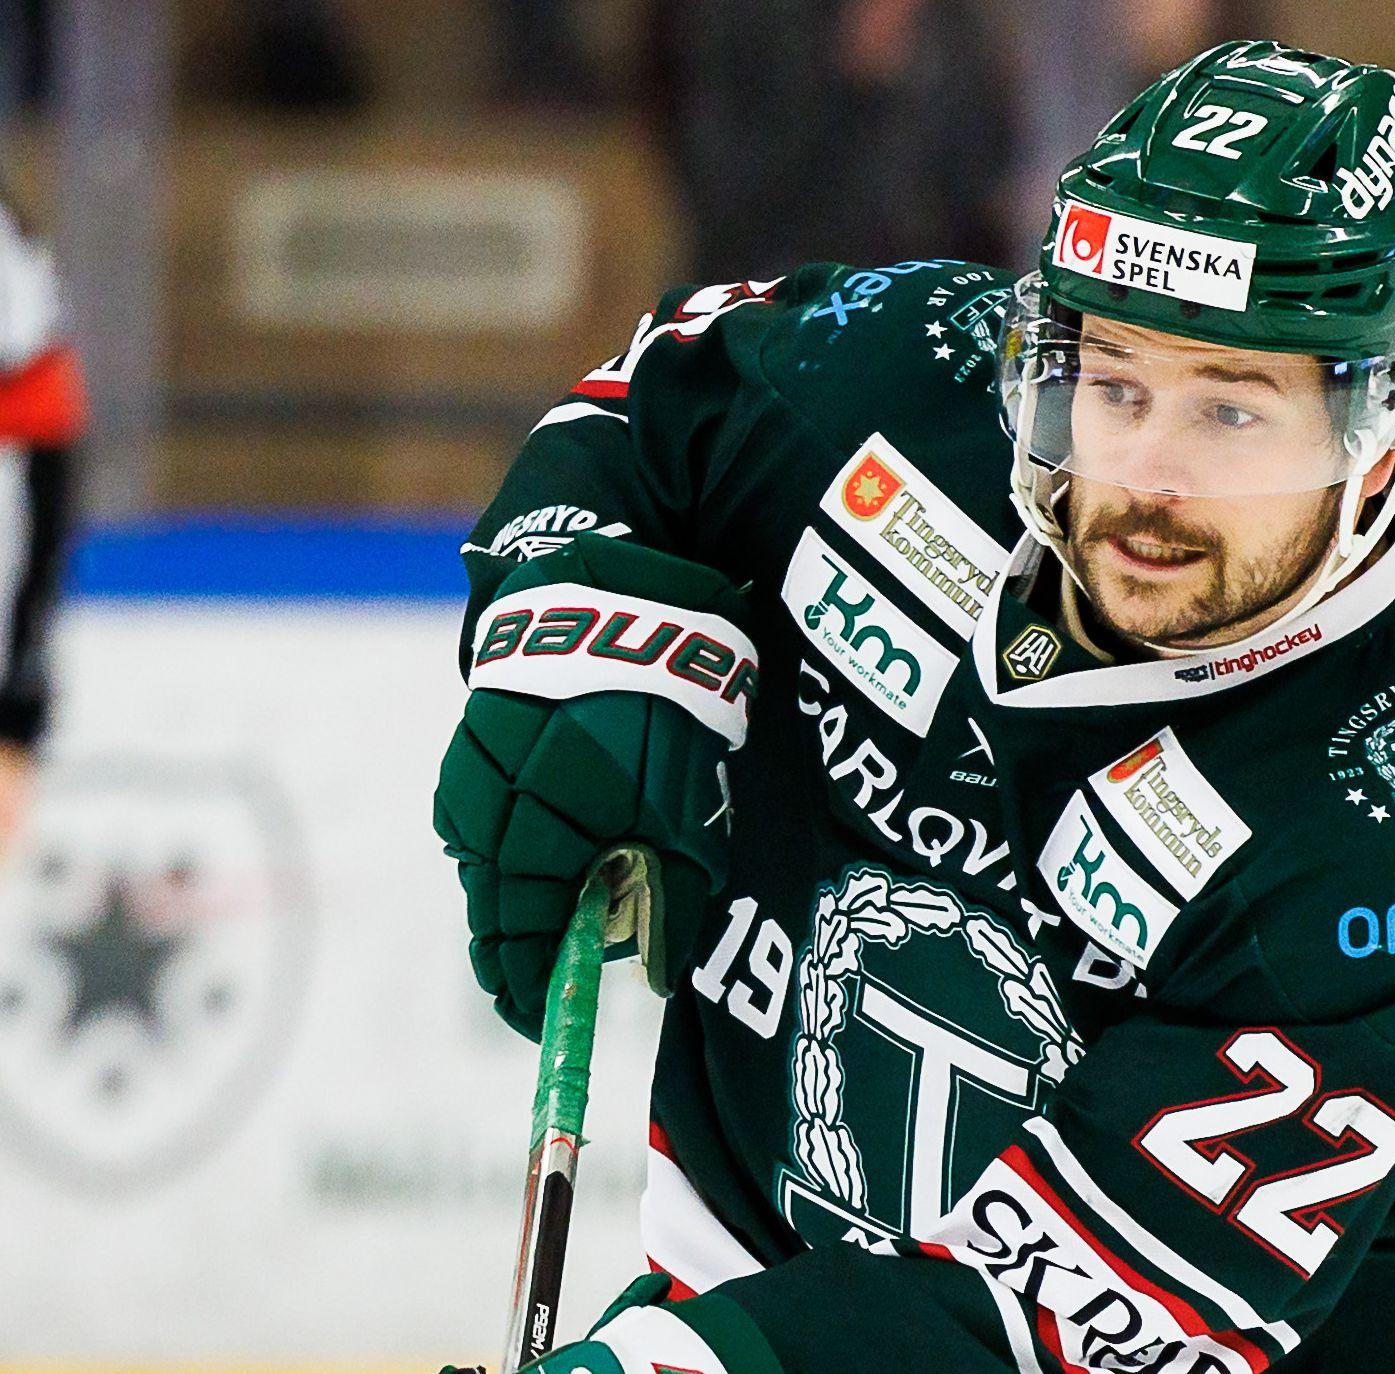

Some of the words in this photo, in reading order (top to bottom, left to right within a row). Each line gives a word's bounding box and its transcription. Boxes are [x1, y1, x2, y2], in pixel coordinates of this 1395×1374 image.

[1172, 104, 1268, 160] 22
[1112, 259, 1175, 292] SPEL
[1115, 233, 1242, 281] SVENSKA
[892, 490, 1001, 598] Tingsryd
[847, 654, 908, 711] workmate
[1328, 767, 1365, 781] 1923
[1140, 755, 1223, 859] Tingsryds
[691, 896, 794, 1040] 19
